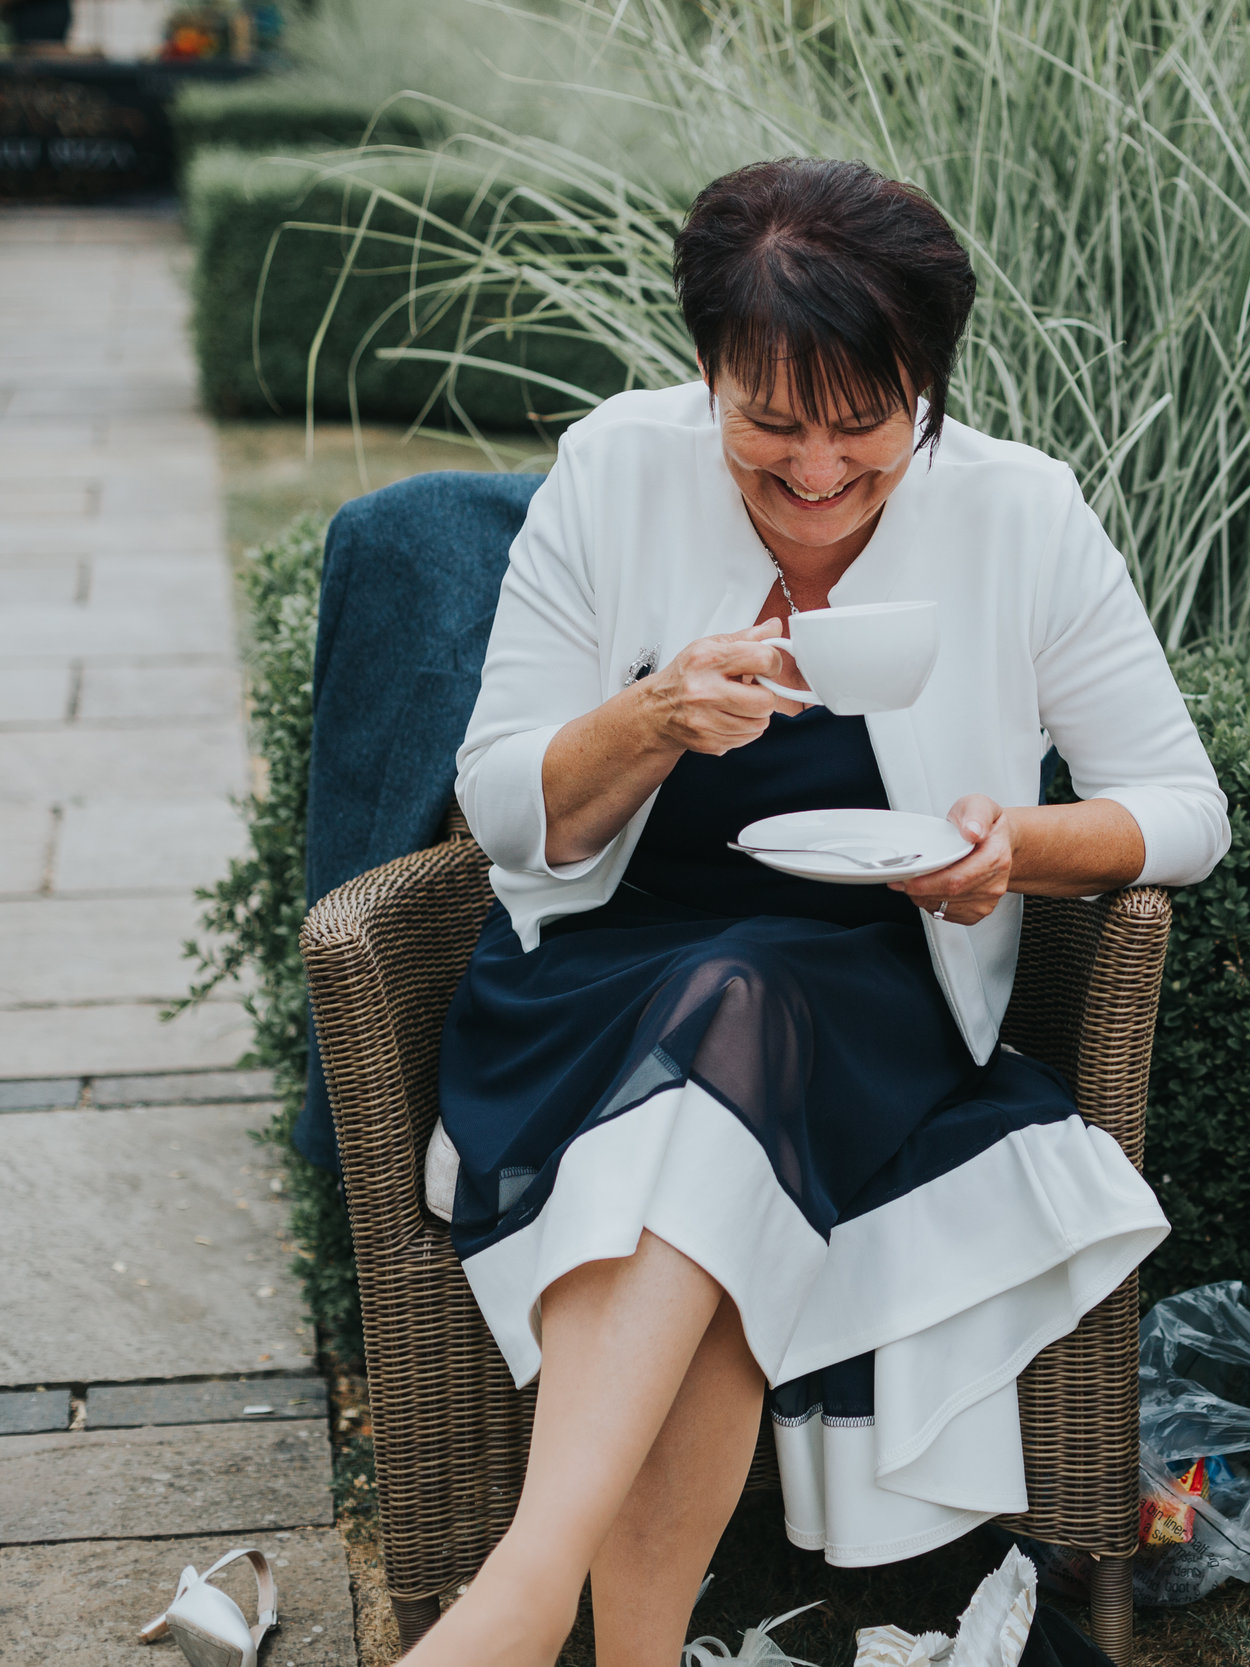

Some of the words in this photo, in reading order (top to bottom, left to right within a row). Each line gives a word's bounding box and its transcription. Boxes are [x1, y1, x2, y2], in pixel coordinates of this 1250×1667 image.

[1140, 1499, 1147, 1508] a
[1147, 1502, 1164, 1520] bin
[1163, 1515, 1188, 1540] liner,
[1188, 1535, 1211, 1555] half
[1143, 1523, 1152, 1533] a
